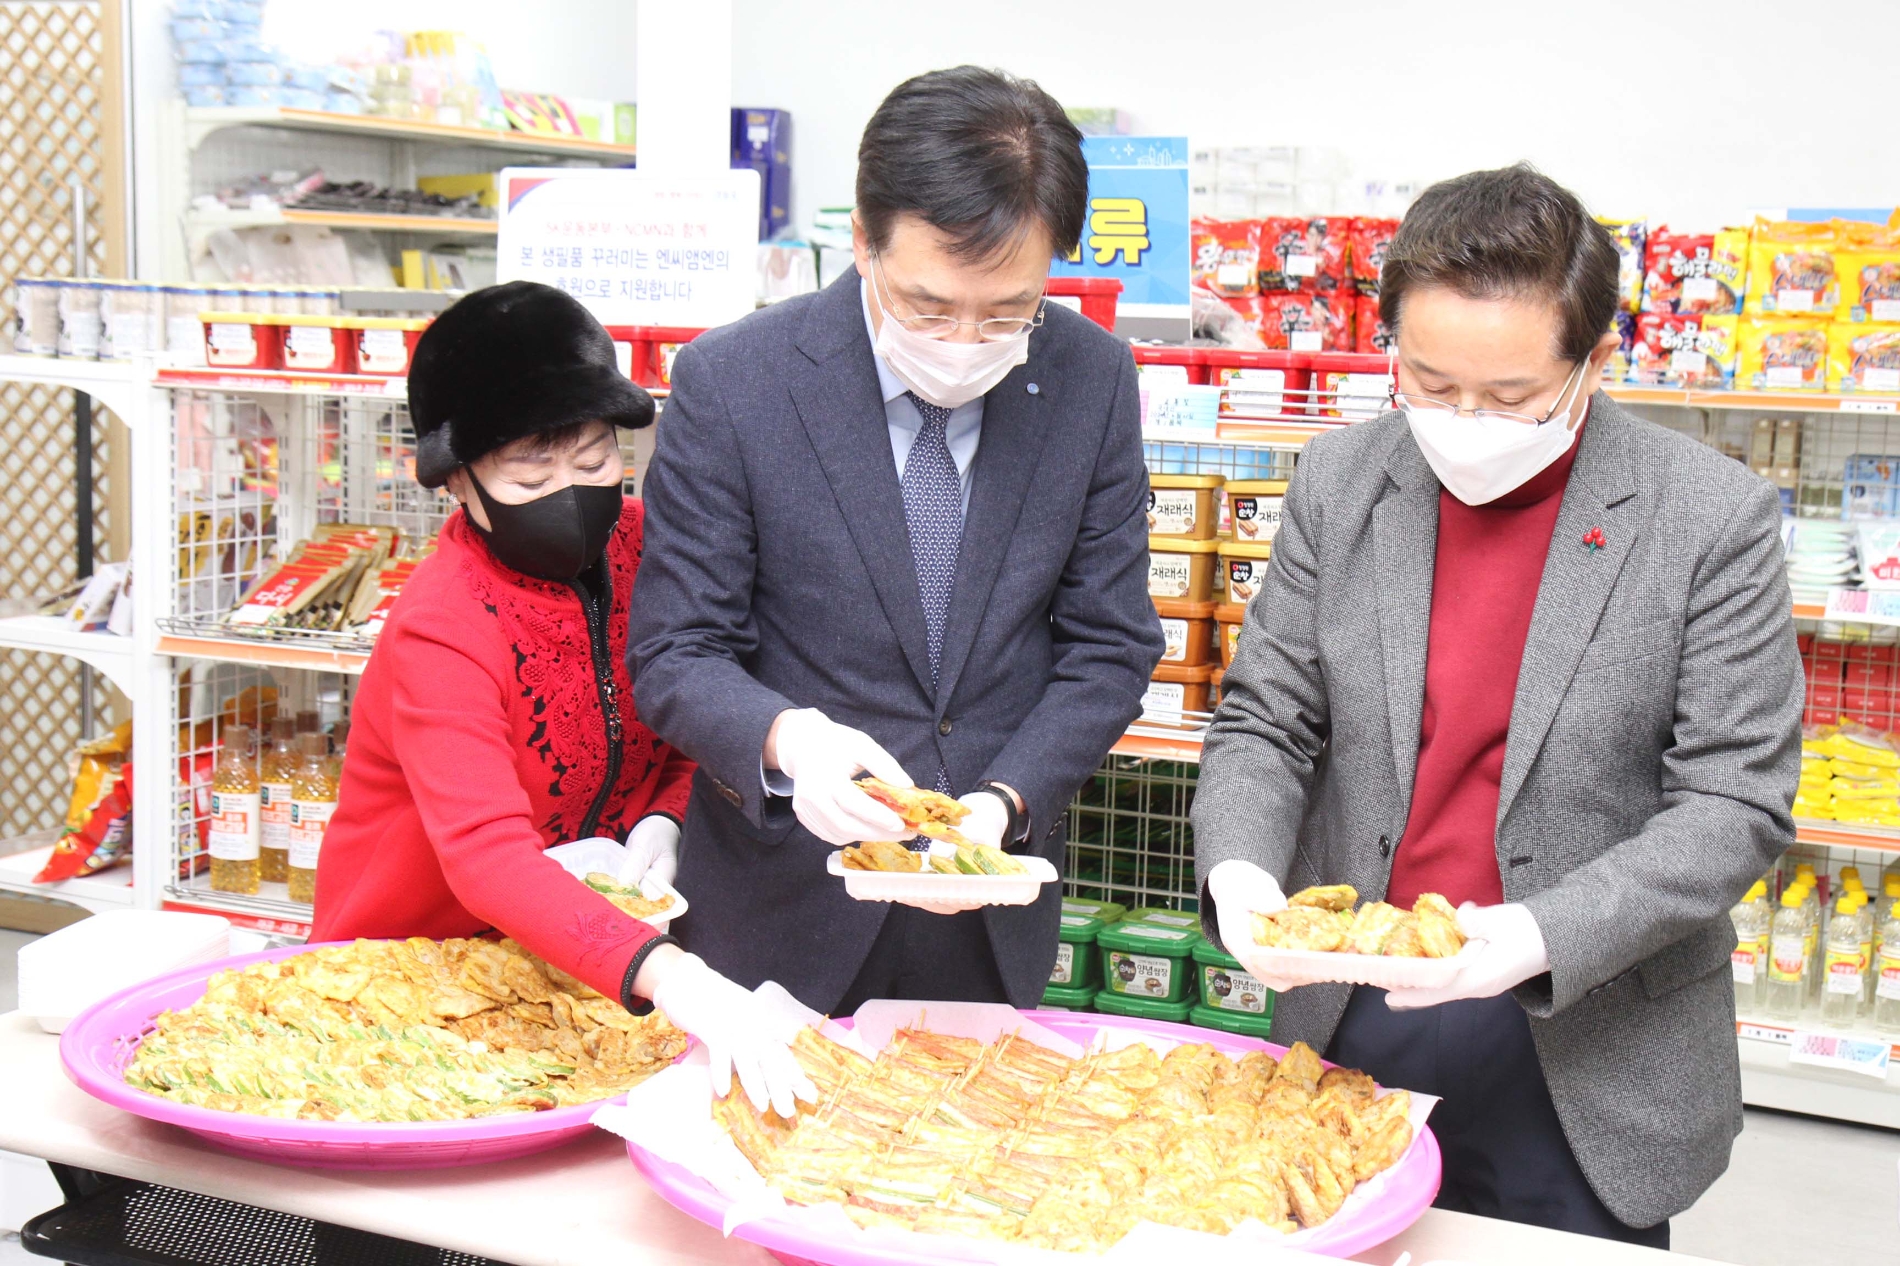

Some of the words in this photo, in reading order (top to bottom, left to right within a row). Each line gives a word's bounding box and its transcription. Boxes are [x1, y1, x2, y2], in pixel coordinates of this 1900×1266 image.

[1068, 198, 1149, 265] 류
[520, 246, 533, 266] 본
[542, 247, 583, 268] 생필품
[591, 248, 649, 270] 꾸러미는
[620, 278, 692, 301] 지원합니다
[1156, 502, 1194, 518] 재래식
[1151, 565, 1188, 582] 재래식
[1137, 964, 1168, 978] 양념쌈장
[1233, 978, 1265, 993] 양념쌈장
